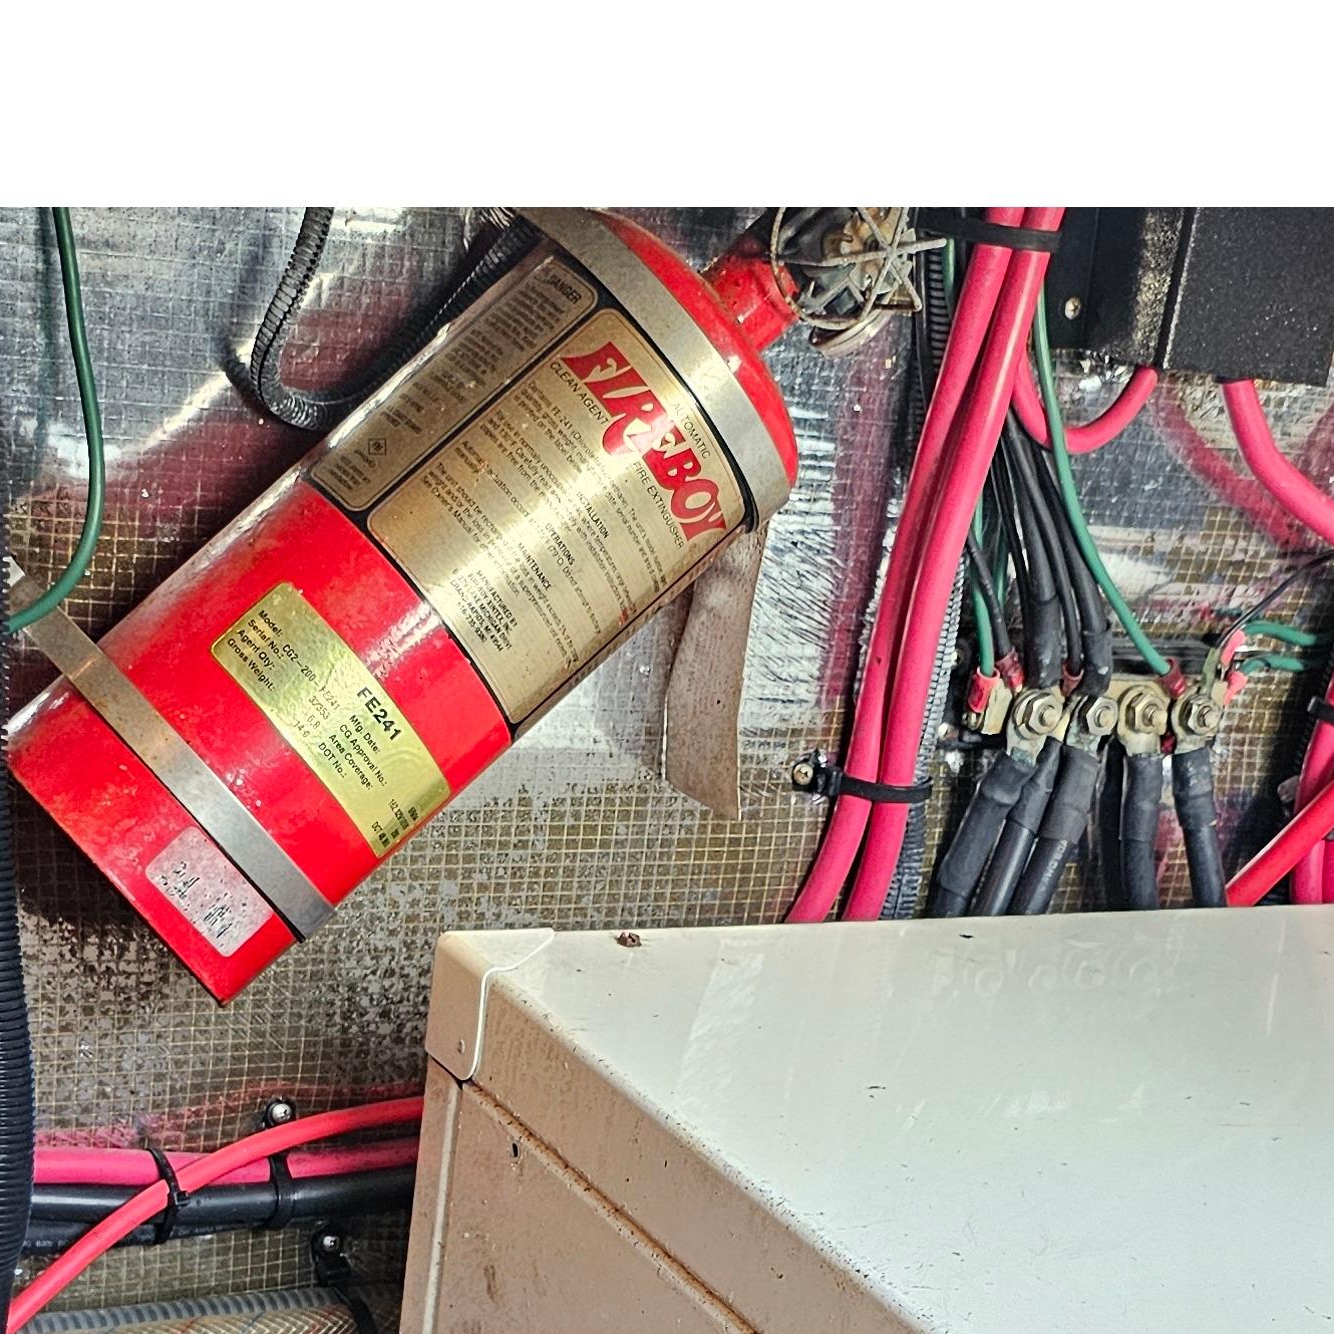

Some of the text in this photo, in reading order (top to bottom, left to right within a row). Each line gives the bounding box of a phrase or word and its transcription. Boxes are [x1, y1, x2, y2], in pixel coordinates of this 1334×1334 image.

[542, 273, 583, 308] DANGER
[548, 359, 609, 426] CLEAN AGENT
[560, 340, 729, 538] FIREBOY
[631, 460, 686, 550] FIRE EXTINGUISHER
[246, 618, 271, 643] Serial
[256, 608, 284, 638] Model:
[225, 637, 250, 663] Gross
[245, 659, 276, 693] Weight:
[234, 628, 276, 672] Agent Qty:
[347, 714, 382, 754] Mfg. Date:
[355, 685, 403, 741] FE241
[317, 741, 348, 779] DOT No.:
[327, 733, 374, 791] Area Coverage:
[338, 723, 353, 739] CG
[347, 737, 379, 773] Approval
